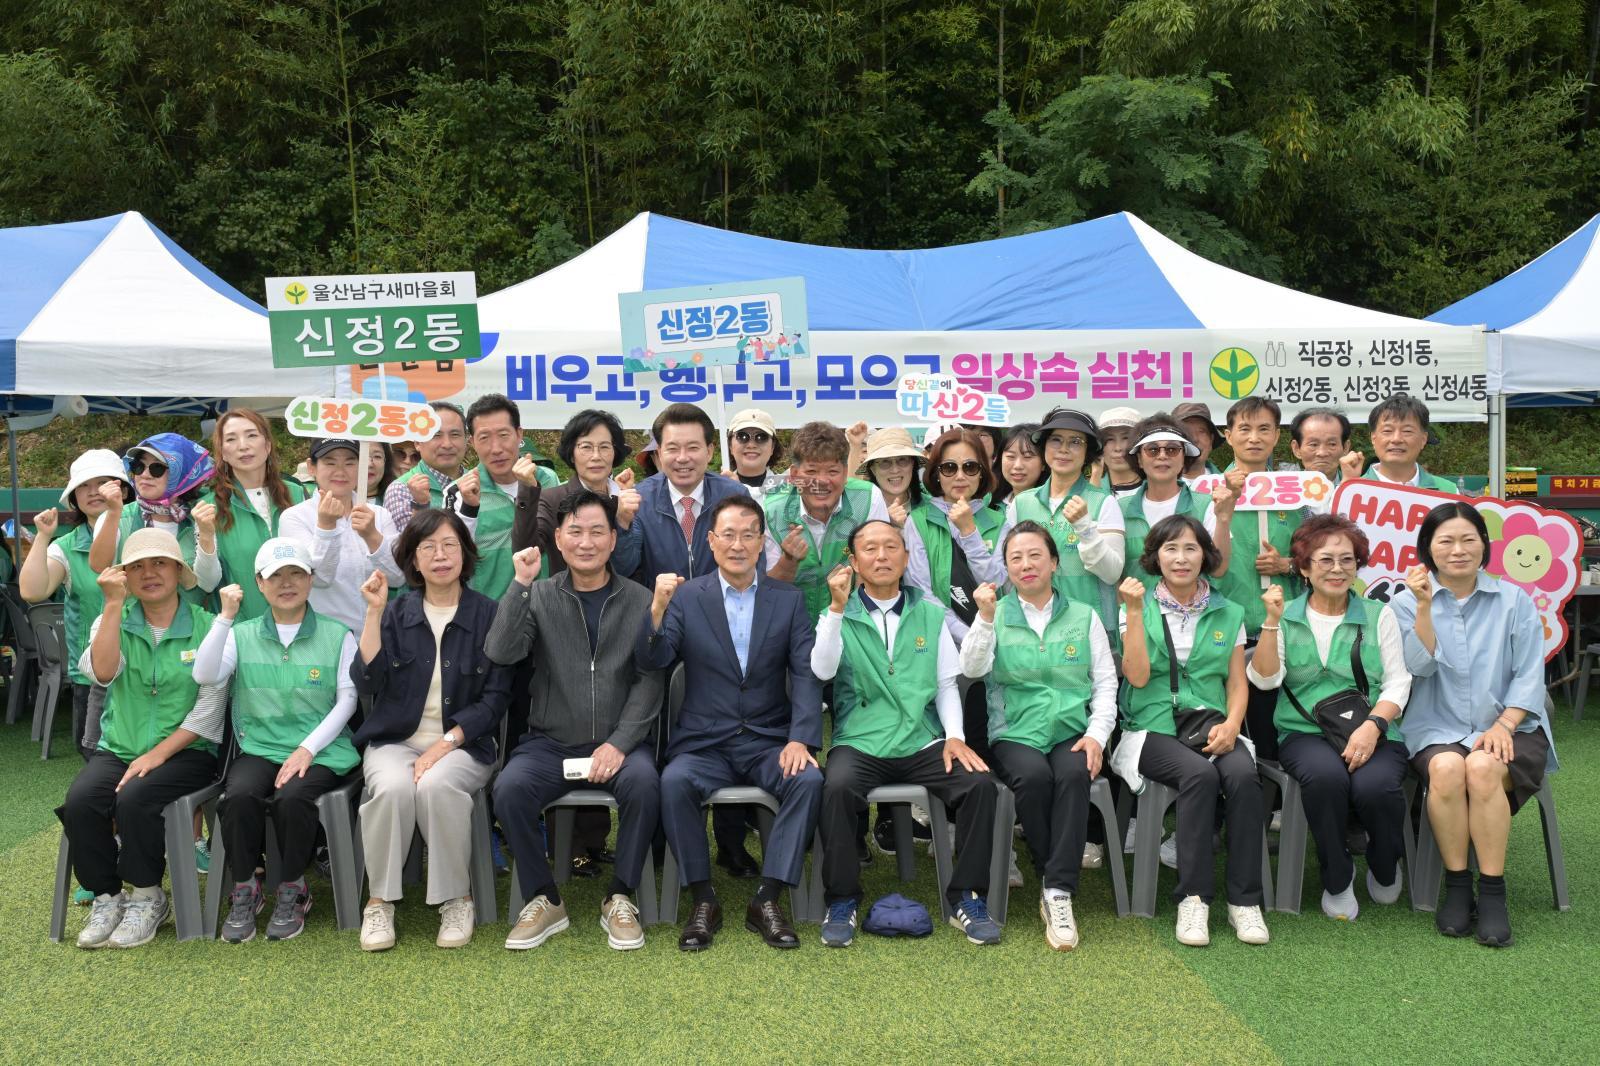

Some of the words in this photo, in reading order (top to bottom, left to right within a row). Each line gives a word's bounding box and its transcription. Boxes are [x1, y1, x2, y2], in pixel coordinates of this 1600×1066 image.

[312, 280, 456, 302] 울산남구새마을회
[294, 312, 464, 358] 신정2동
[655, 300, 772, 342] 신정2동
[1368, 339, 1439, 368] 신정1동,
[951, 351, 1080, 401] 일상속
[1087, 350, 1193, 399] 실천!
[1265, 376, 1338, 405] 신정2동,
[1421, 374, 1487, 402] 신정4동
[291, 400, 409, 437] 신정2동
[900, 391, 1008, 423] 따신2들
[1349, 493, 1432, 532] HAP
